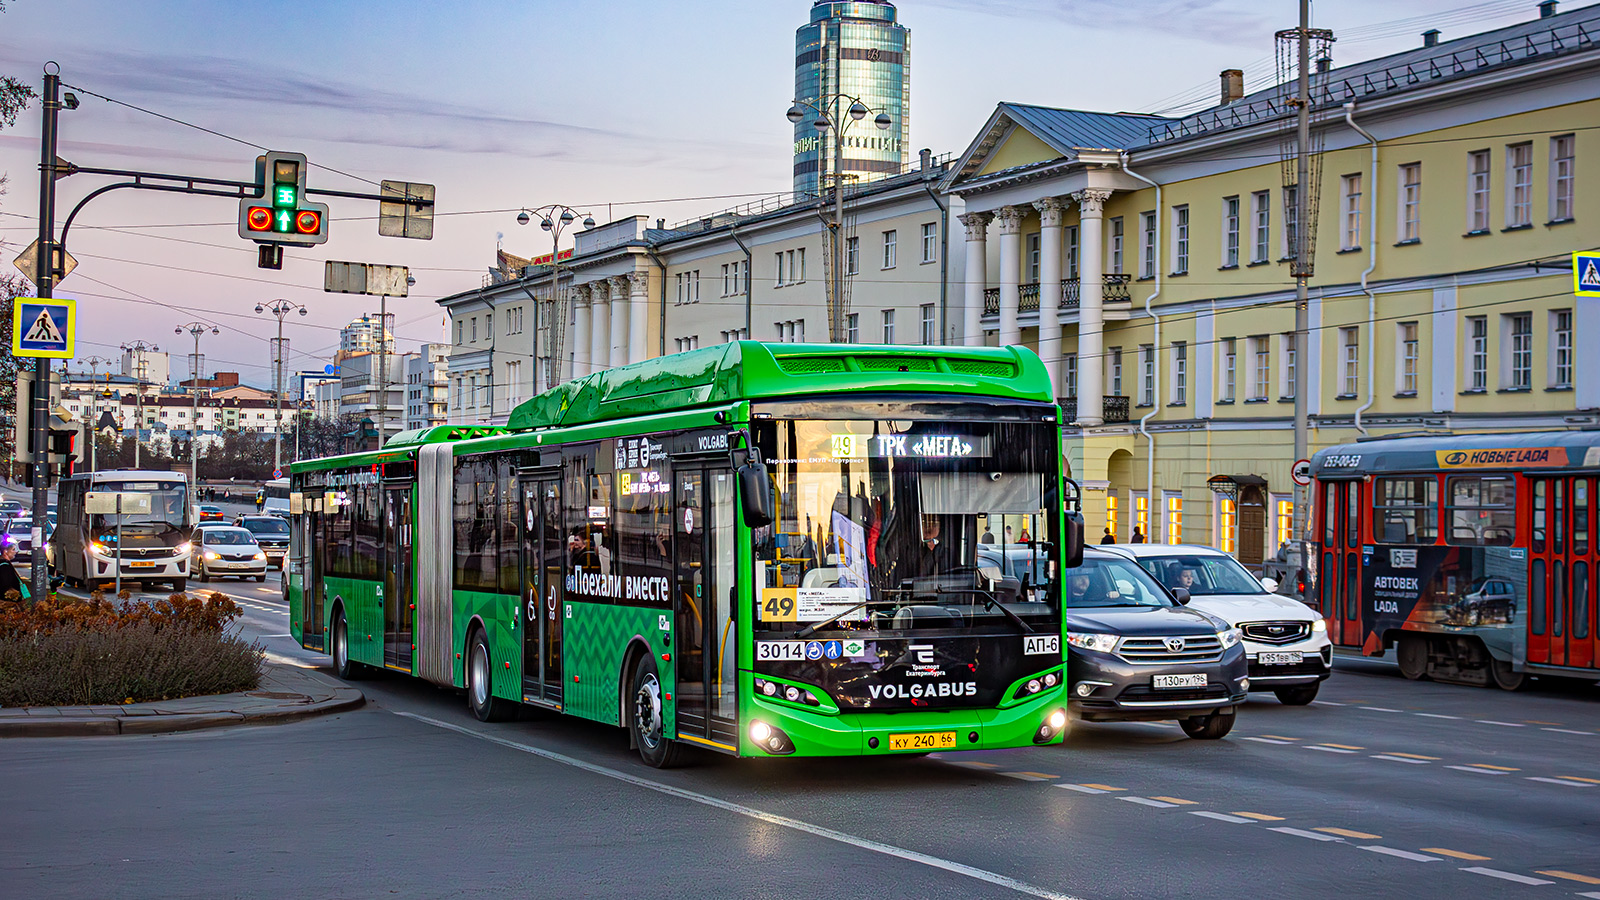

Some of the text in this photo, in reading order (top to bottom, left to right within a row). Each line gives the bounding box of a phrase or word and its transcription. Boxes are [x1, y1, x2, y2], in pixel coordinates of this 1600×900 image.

[279, 190, 293, 203] 36
[832, 436, 973, 456] 49 ТРК «МЕГА»
[1324, 454, 1361, 467] 253-00-53
[1471, 450, 1548, 463] НОВЫЕ LADA
[575, 565, 669, 601] Поехали вместе
[1374, 576, 1418, 590] АВТОВЕК
[765, 598, 794, 616] 49
[1374, 600, 1398, 613] LADA
[760, 643, 802, 658] 3014
[1026, 638, 1057, 653] АП-6
[1156, 675, 1205, 687] Т130РУ 196
[868, 682, 977, 698] VOLGABUS
[895, 734, 952, 748] КУ 240 66
